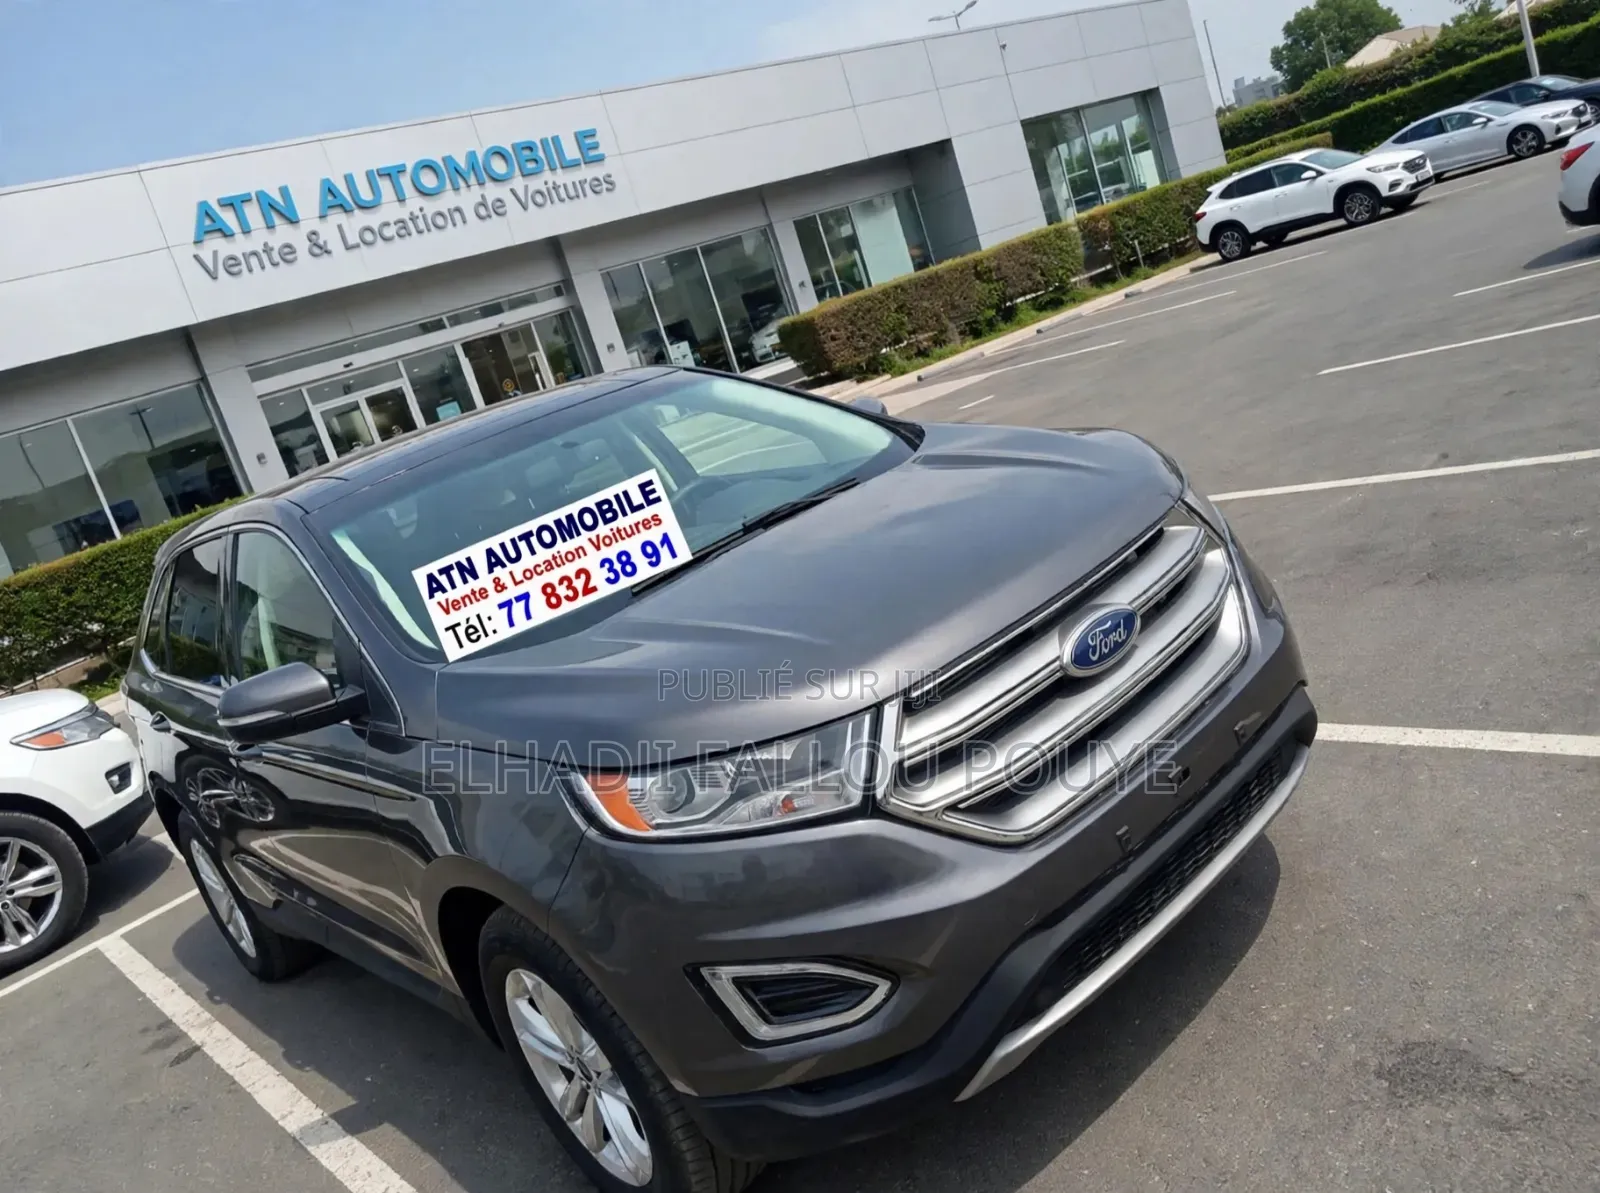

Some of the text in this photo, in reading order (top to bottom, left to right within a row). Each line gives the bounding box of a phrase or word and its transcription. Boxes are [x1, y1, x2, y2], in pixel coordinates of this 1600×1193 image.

[193, 127, 606, 244] ATN AUTOMOBILE
[193, 170, 617, 281] Vente & Location de Voitures
[425, 479, 662, 600] ATN AUTOMOBILE
[437, 513, 663, 616] Vente & Location Voitures
[444, 532, 678, 650] Tél: 77 832 38 91
[1088, 618, 1127, 661] Ford
